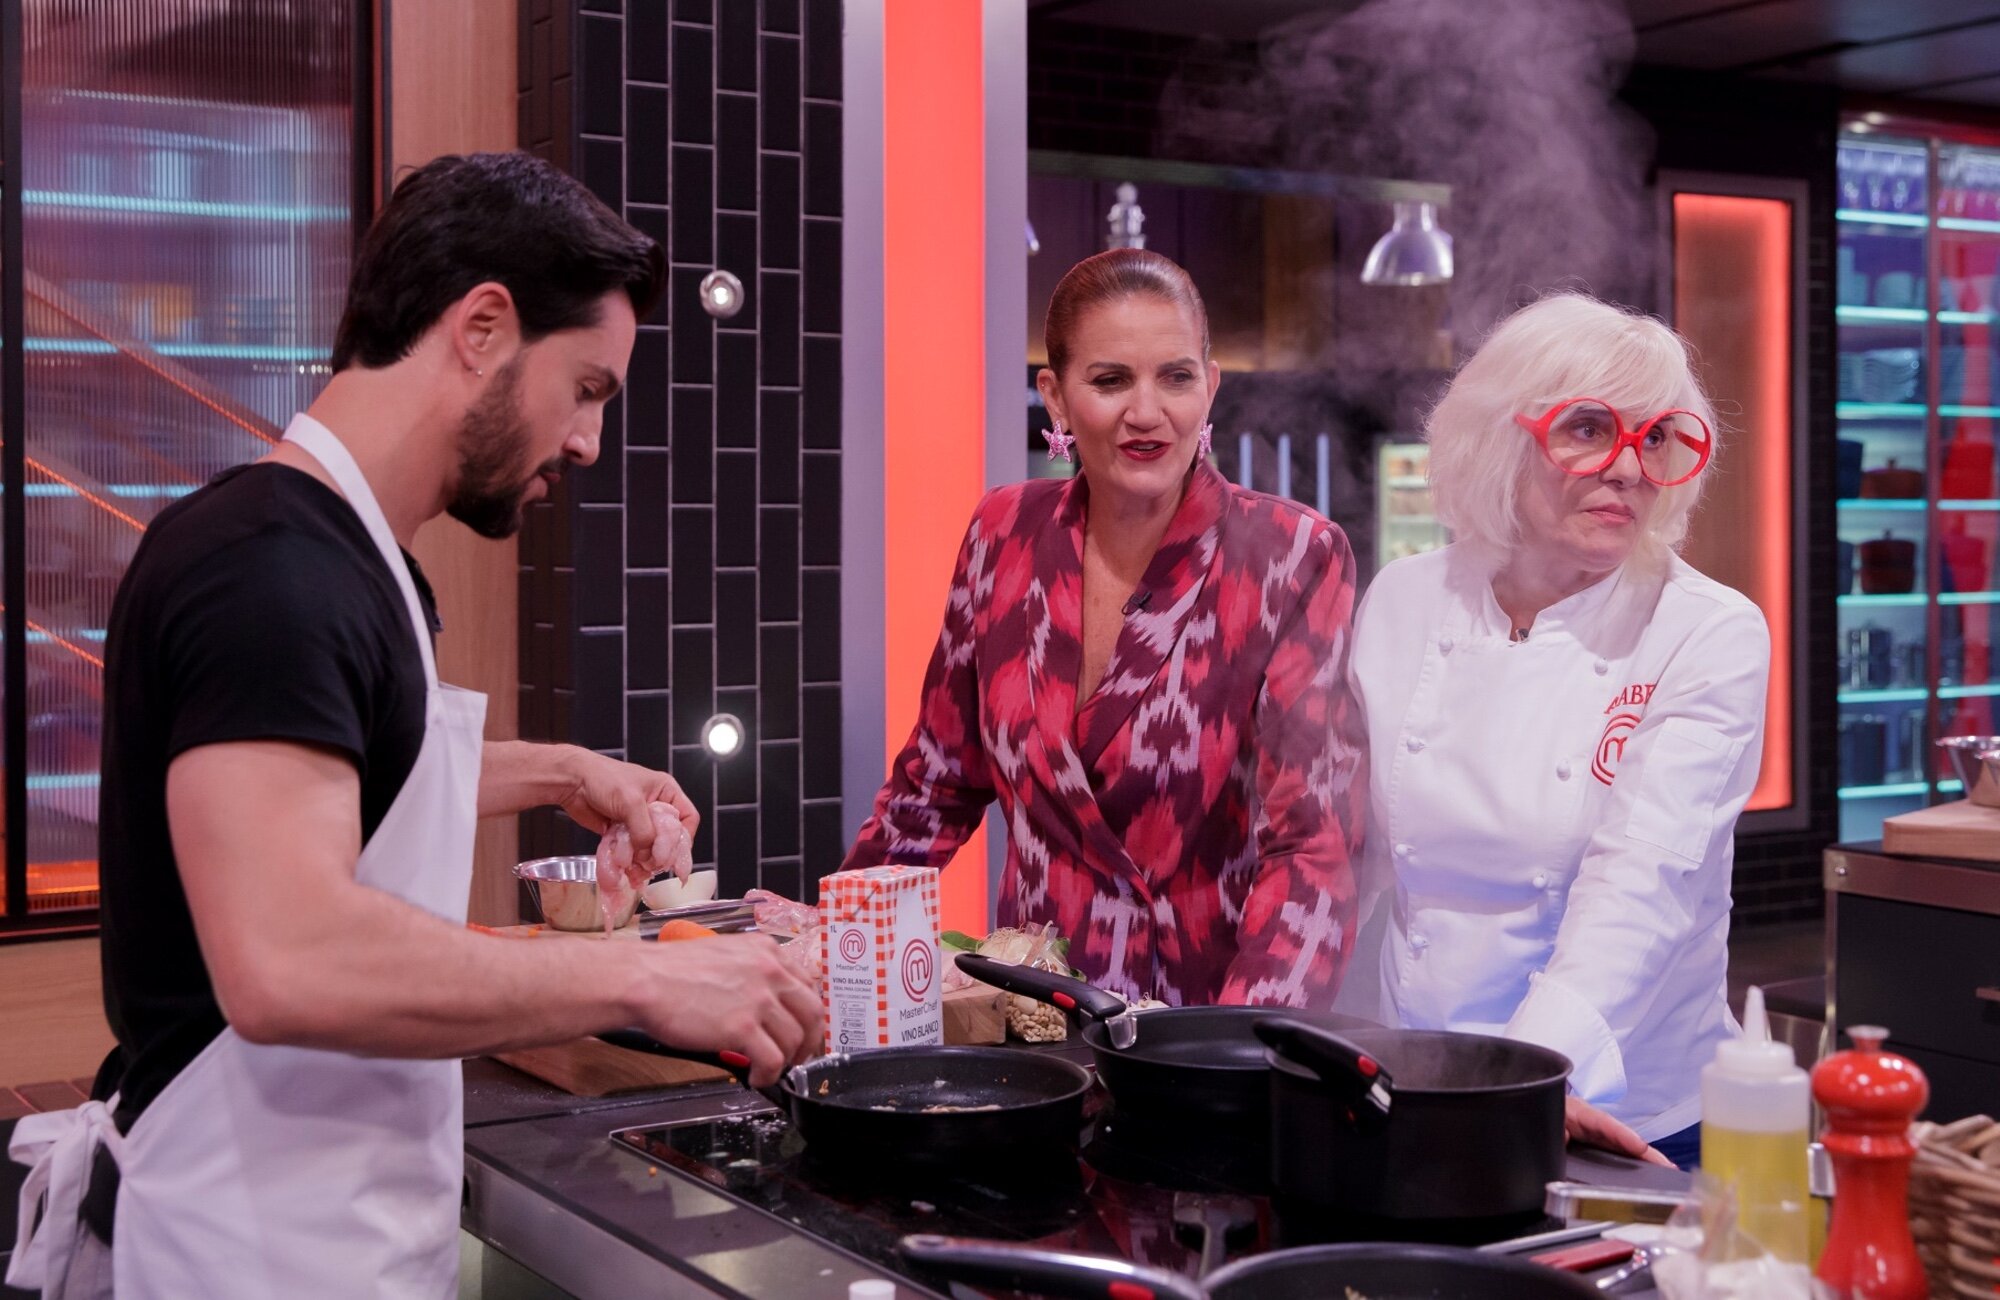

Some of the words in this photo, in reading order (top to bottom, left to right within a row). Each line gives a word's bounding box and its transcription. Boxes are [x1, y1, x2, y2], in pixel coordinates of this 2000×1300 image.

[830, 924, 837, 933] 1L
[836, 963, 869, 971] MasterChef
[899, 999, 938, 1021] MasterChef
[901, 1027, 917, 1042] VINO
[918, 1020, 939, 1038] BLANCO
